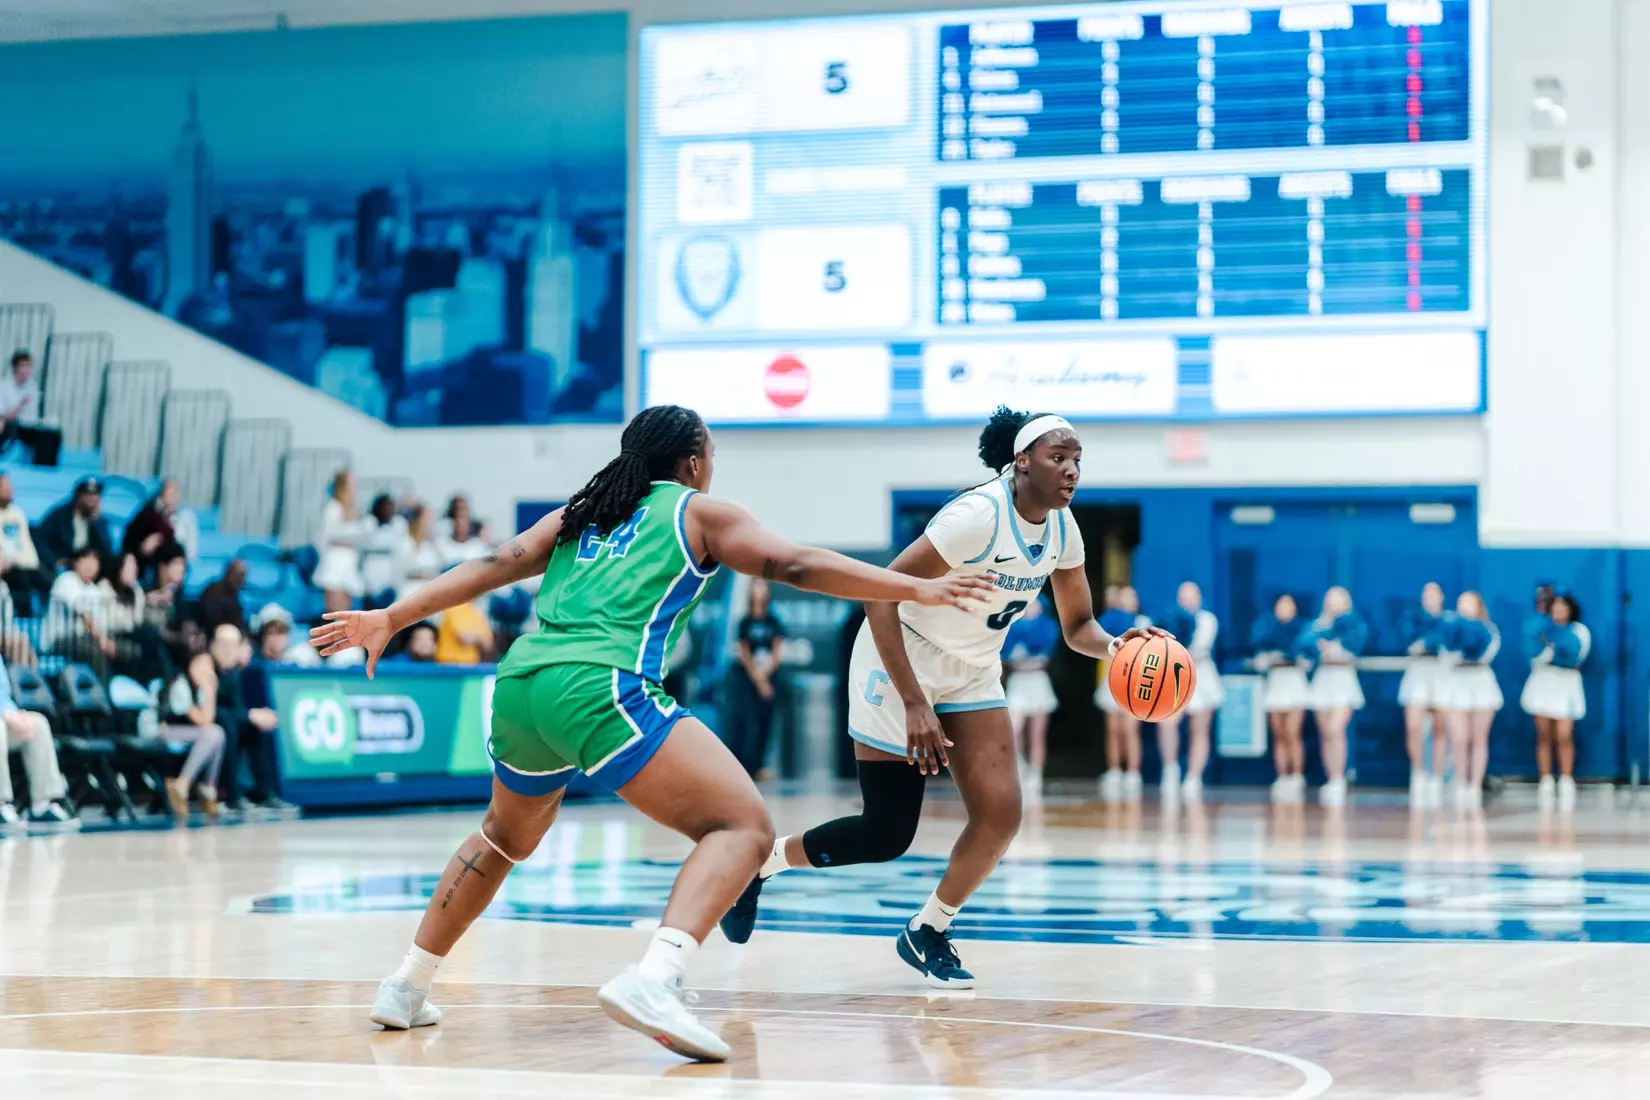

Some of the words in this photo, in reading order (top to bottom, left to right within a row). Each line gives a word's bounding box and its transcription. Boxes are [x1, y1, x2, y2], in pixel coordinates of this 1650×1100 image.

[825, 61, 849, 94] 5
[825, 260, 848, 292] 5
[575, 506, 650, 561] 24
[986, 600, 1028, 631] 0
[864, 669, 891, 708] C
[294, 698, 346, 750] GO
